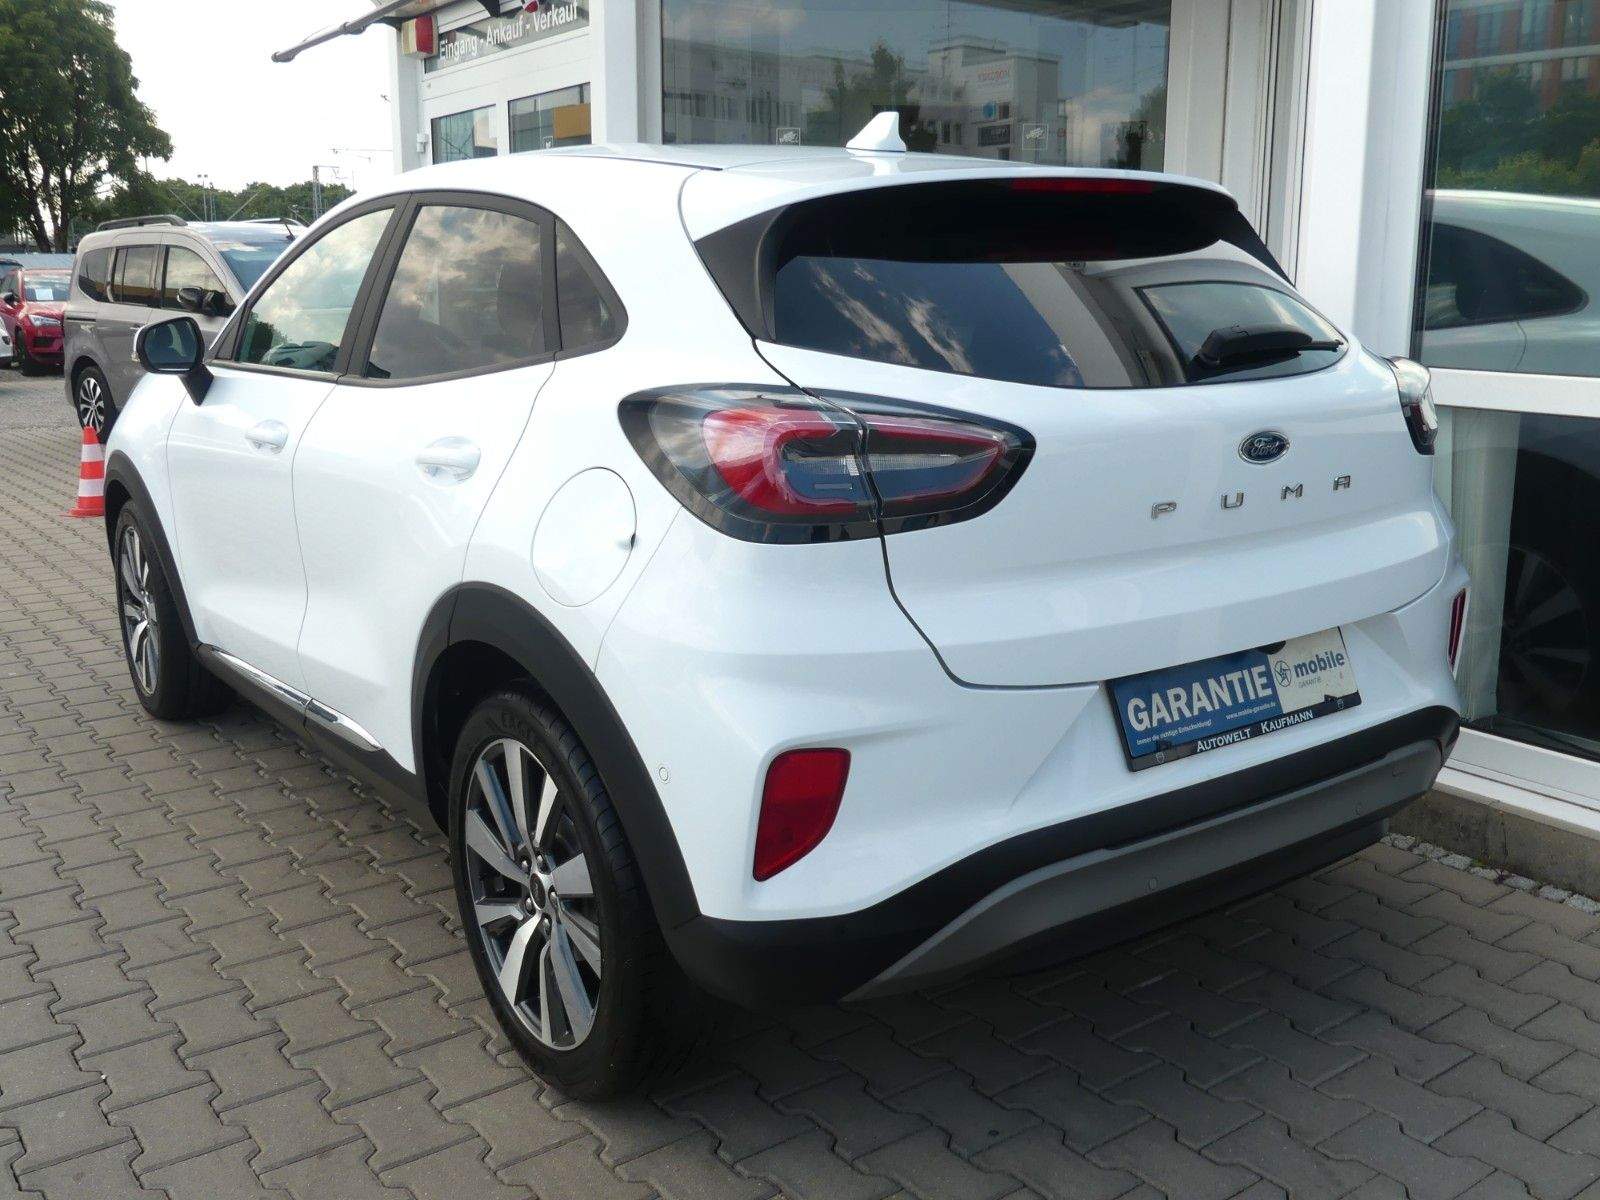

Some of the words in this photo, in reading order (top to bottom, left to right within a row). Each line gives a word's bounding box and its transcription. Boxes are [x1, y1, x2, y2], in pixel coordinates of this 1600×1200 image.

[439, 35, 479, 61] Eingang
[486, 14, 524, 46] Ankauf
[533, 1, 578, 31] Verkauf
[1293, 650, 1345, 678] mobile
[1127, 665, 1273, 731] GARANTIE
[1197, 728, 1251, 752] AUTOWELT
[1260, 709, 1314, 734] KAUFMANN
